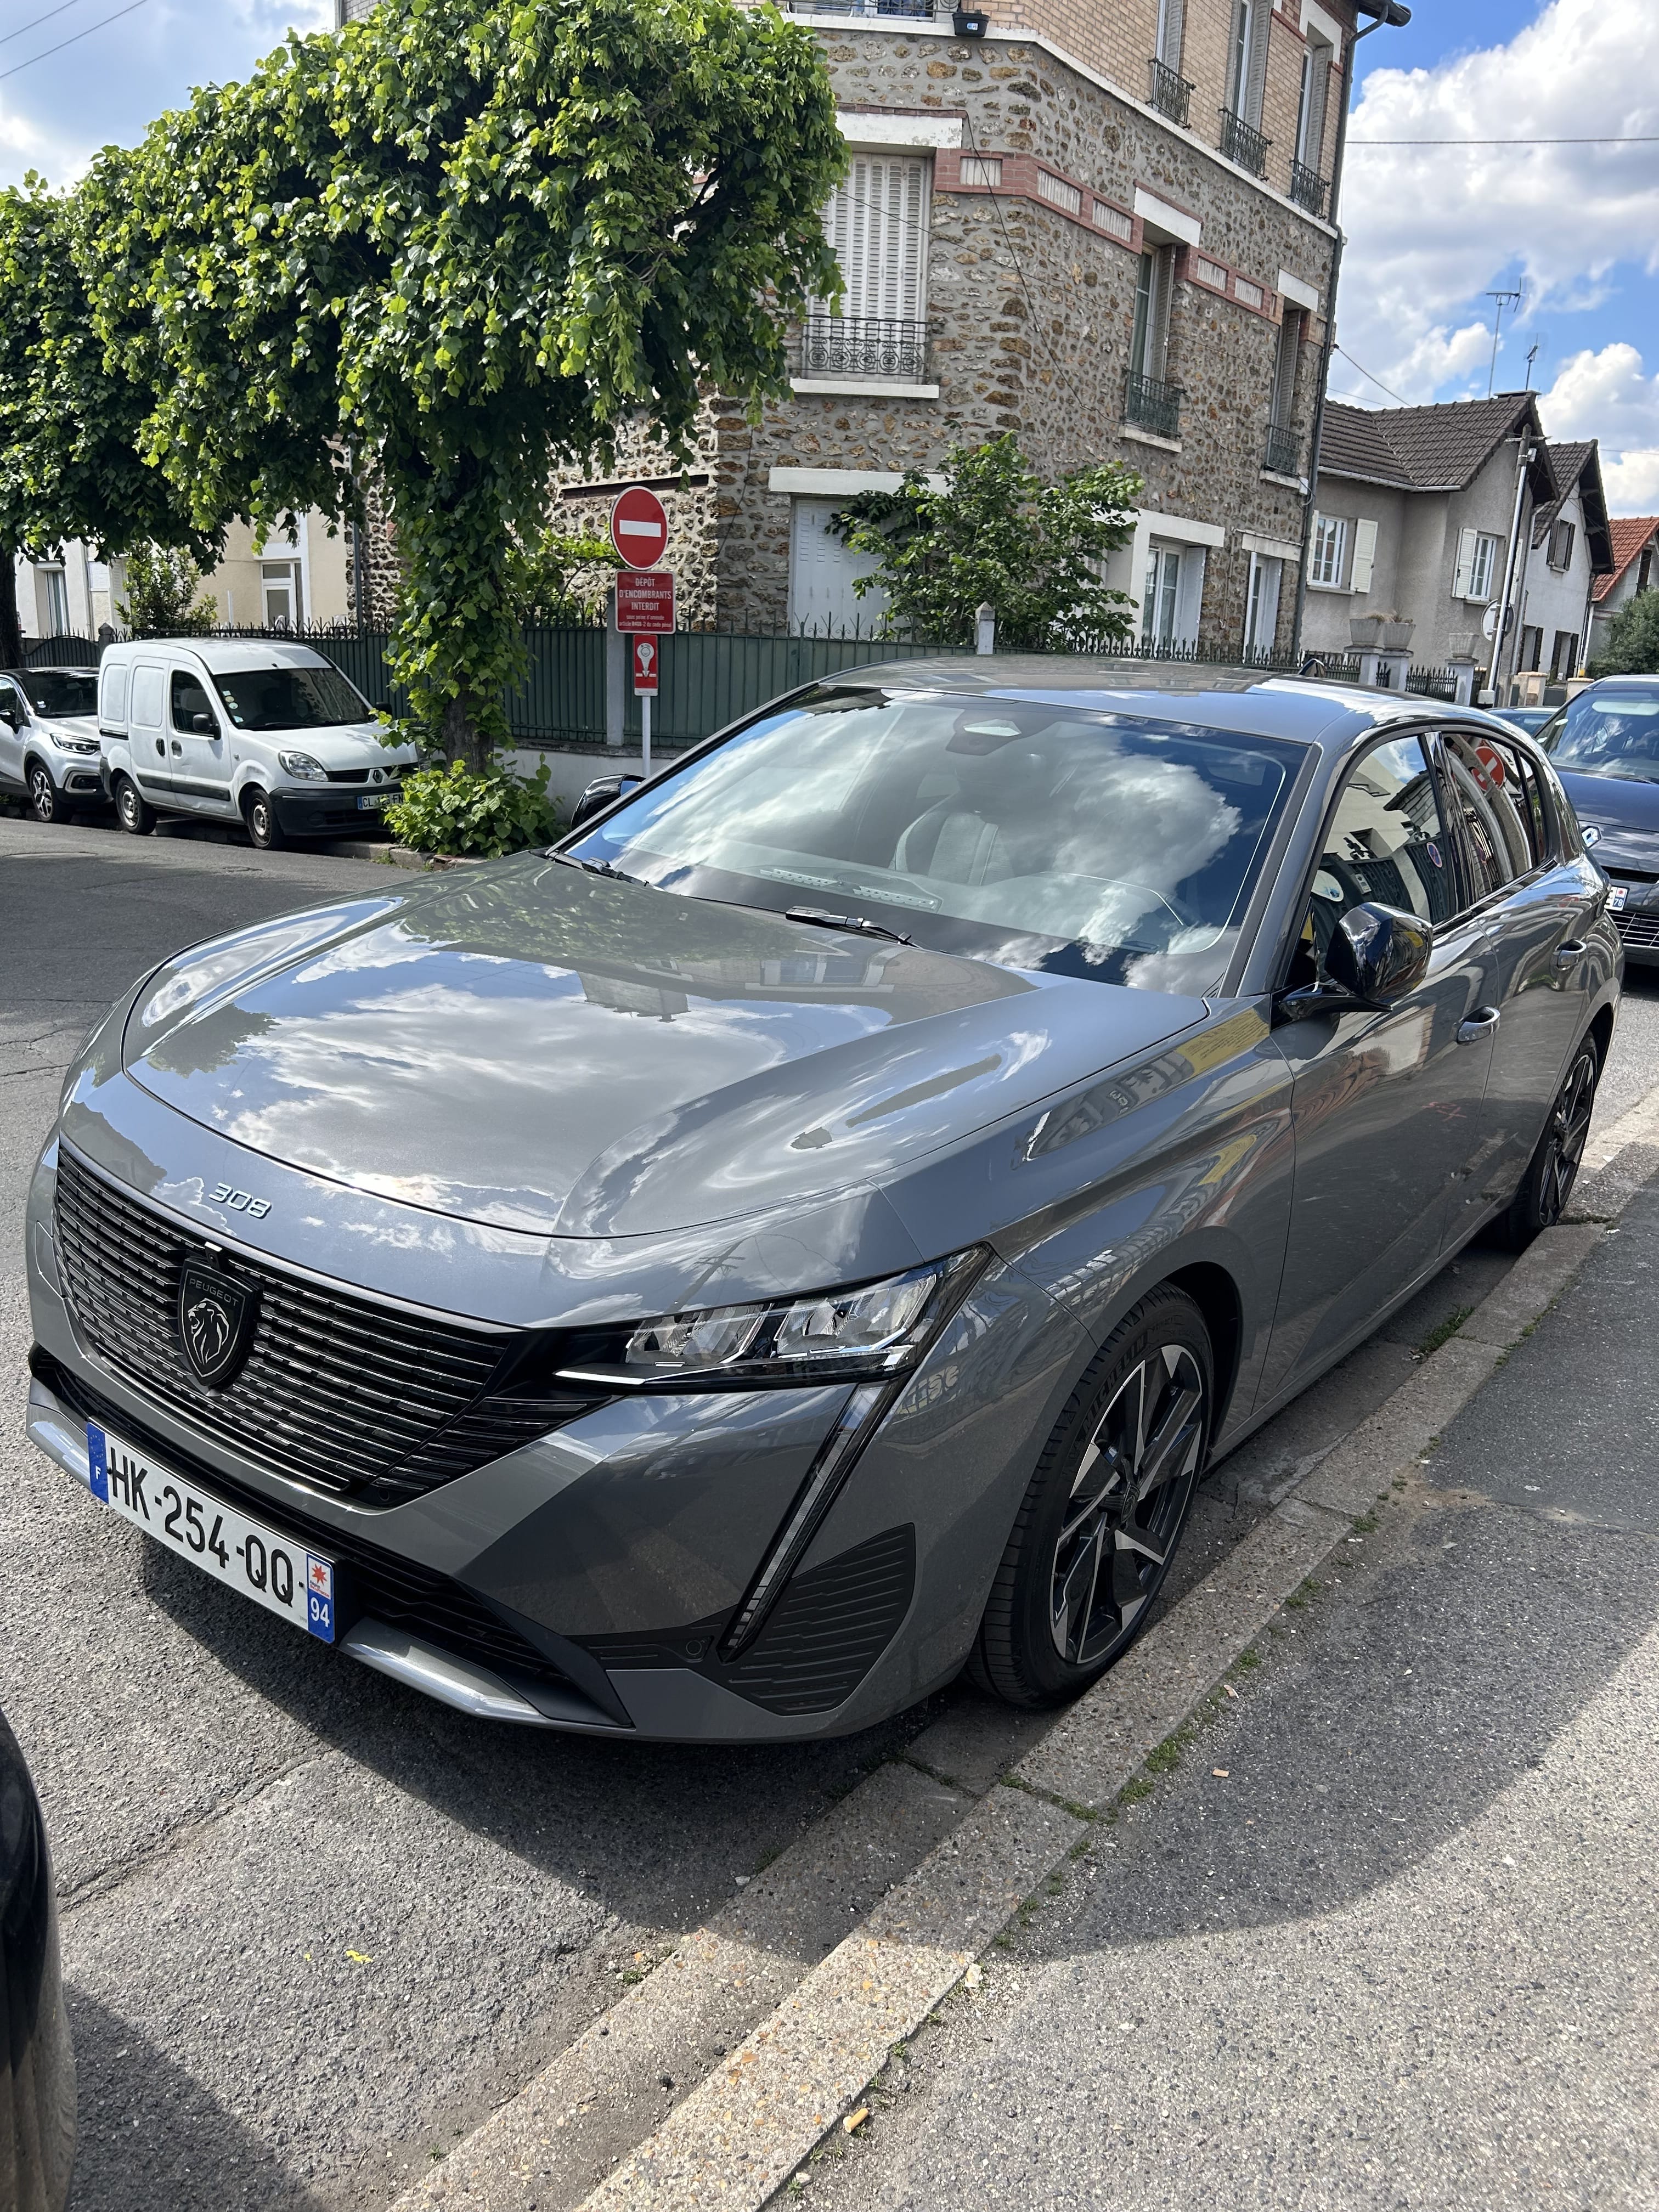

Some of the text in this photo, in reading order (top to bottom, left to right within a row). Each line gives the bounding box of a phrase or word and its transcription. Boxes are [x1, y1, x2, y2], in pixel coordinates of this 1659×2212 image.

[635, 577, 655, 586] DÉPÔT
[619, 590, 672, 599] D'ENCOMBRANTS
[631, 602, 659, 611] INTERDIT
[1613, 898, 1623, 906] 78
[208, 1182, 272, 1219] 308
[189, 1278, 239, 1306] PEUGEOT
[1083, 1334, 1147, 1432] MICHELIN
[95, 1465, 101, 1480] F
[111, 1447, 293, 1608] HK-254-QQ
[311, 1597, 330, 1628] 94
